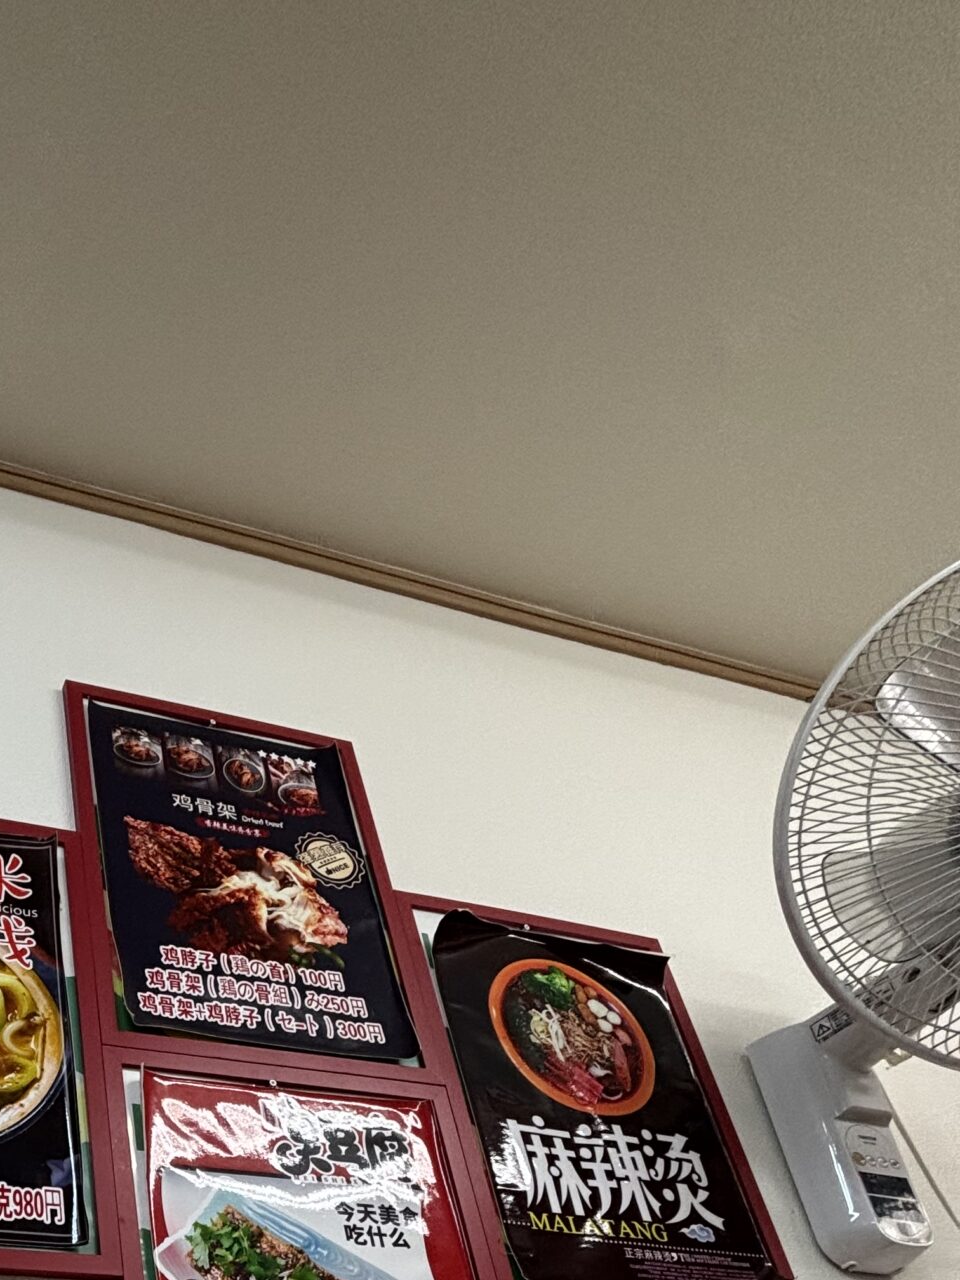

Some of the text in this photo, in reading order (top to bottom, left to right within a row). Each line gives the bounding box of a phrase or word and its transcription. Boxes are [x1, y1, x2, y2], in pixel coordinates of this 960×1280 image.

[171, 793, 238, 821] 鸡骨架
[501, 1114, 727, 1232] 麻辣烫
[343, 1223, 412, 1250] 吃什么
